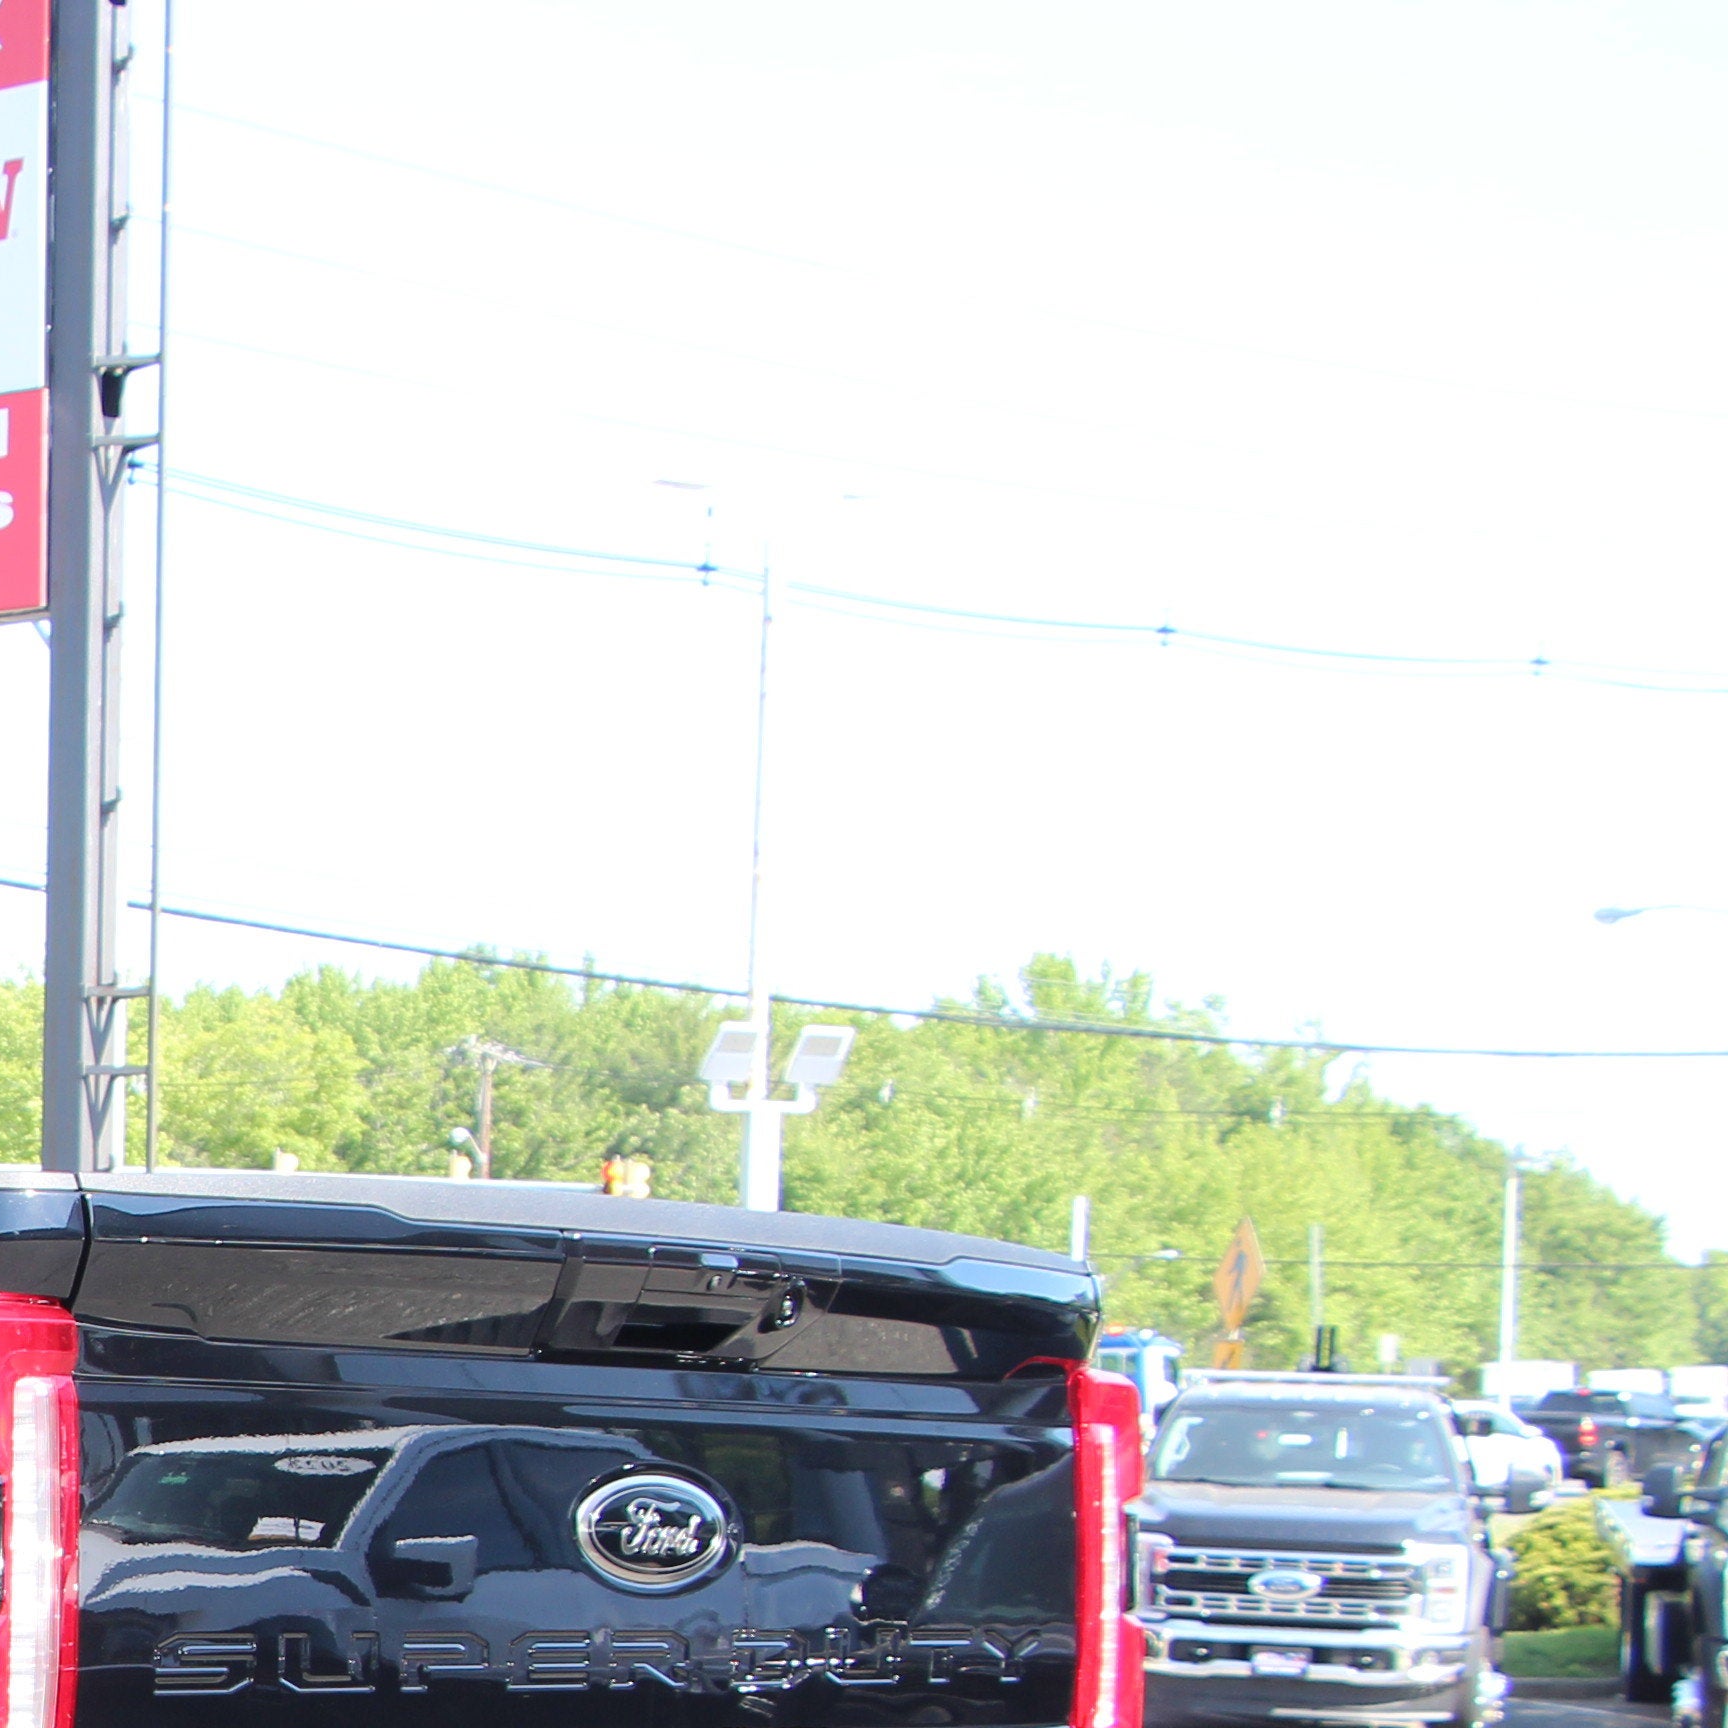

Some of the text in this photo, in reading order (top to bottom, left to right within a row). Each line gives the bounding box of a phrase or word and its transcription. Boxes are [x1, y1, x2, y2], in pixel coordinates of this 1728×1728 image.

[620, 1497, 702, 1556] Ford
[152, 1626, 1043, 1697] SUPER DUTY
